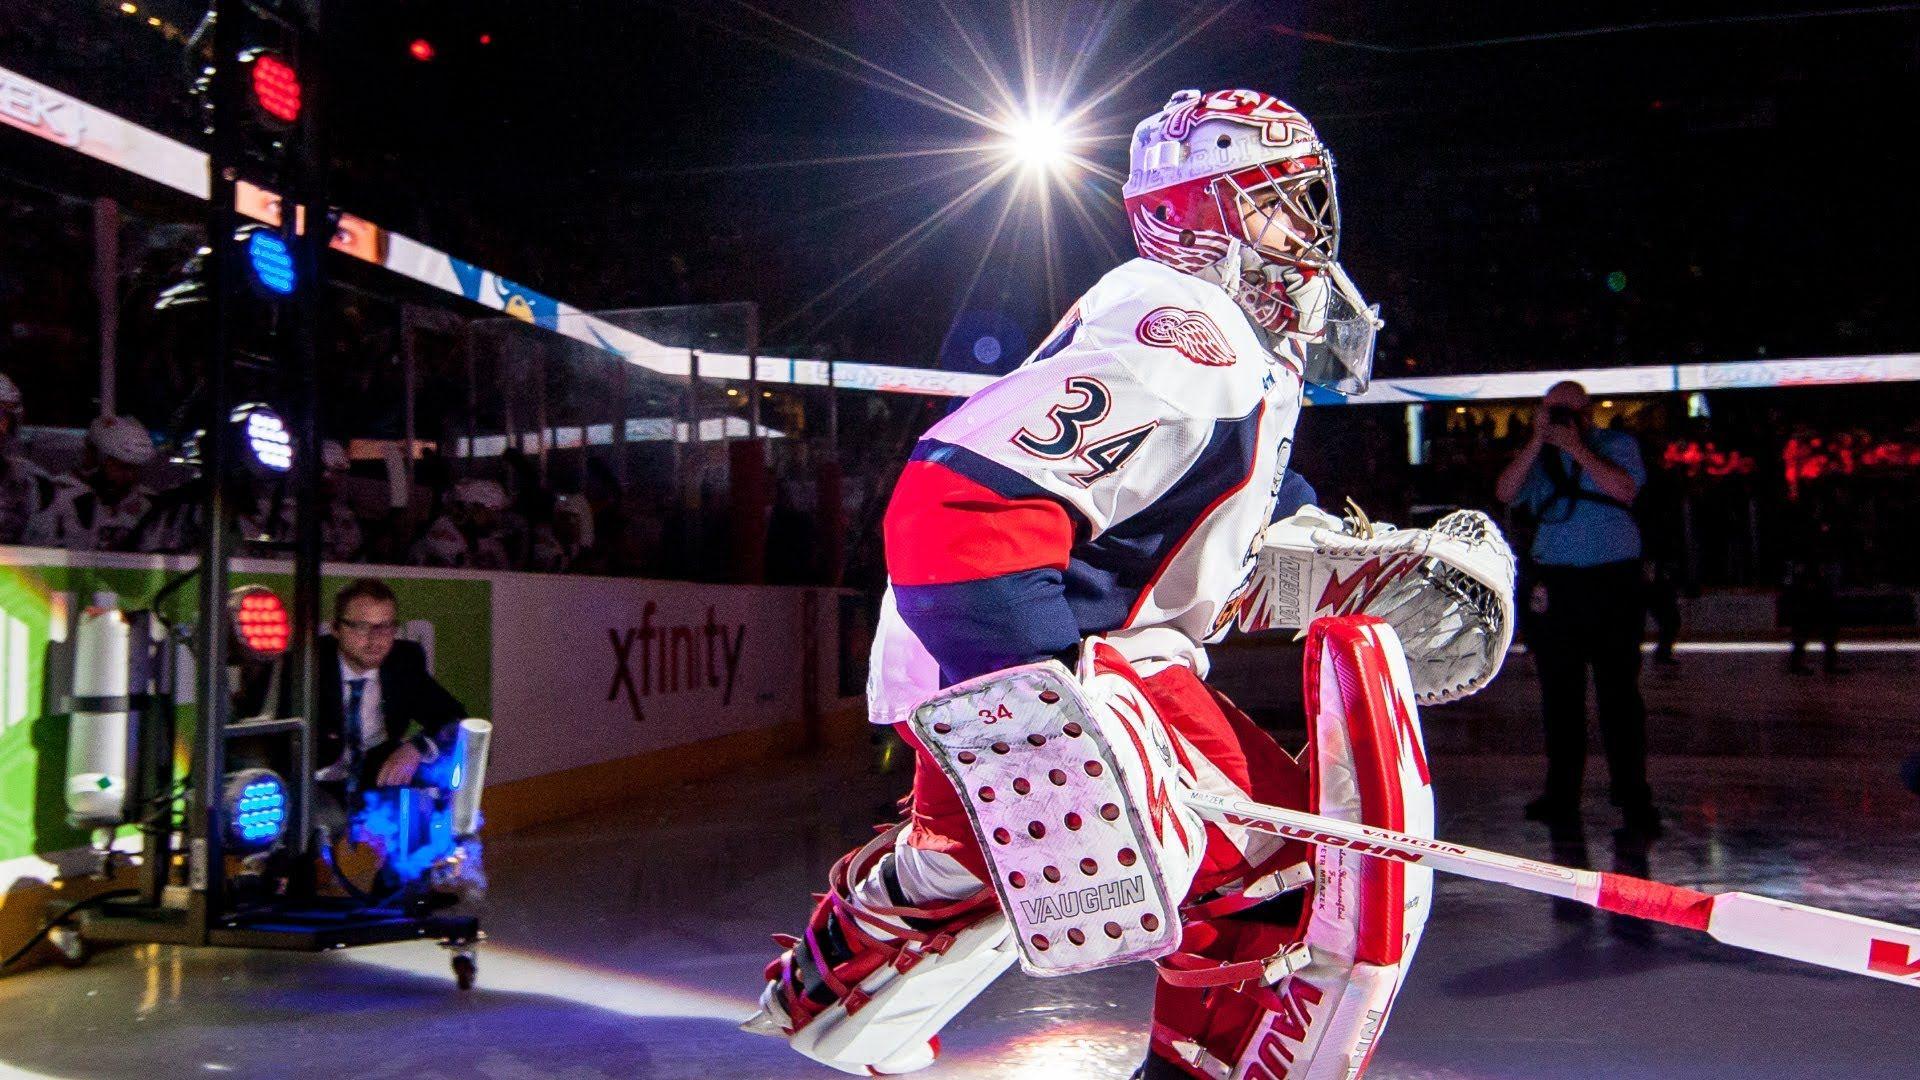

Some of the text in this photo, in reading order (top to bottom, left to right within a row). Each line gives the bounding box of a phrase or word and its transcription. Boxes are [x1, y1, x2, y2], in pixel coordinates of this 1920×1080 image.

[1008, 377, 1160, 488] 34
[1280, 555, 1301, 627] VAUGHN
[607, 601, 746, 721] xfinity
[978, 703, 1013, 725] 34
[1223, 812, 1425, 863] VAUGHN
[1362, 828, 1466, 855] VAUGHN
[1021, 875, 1146, 925] VAUGHN
[1318, 845, 1328, 911] ETR MRAZEK
